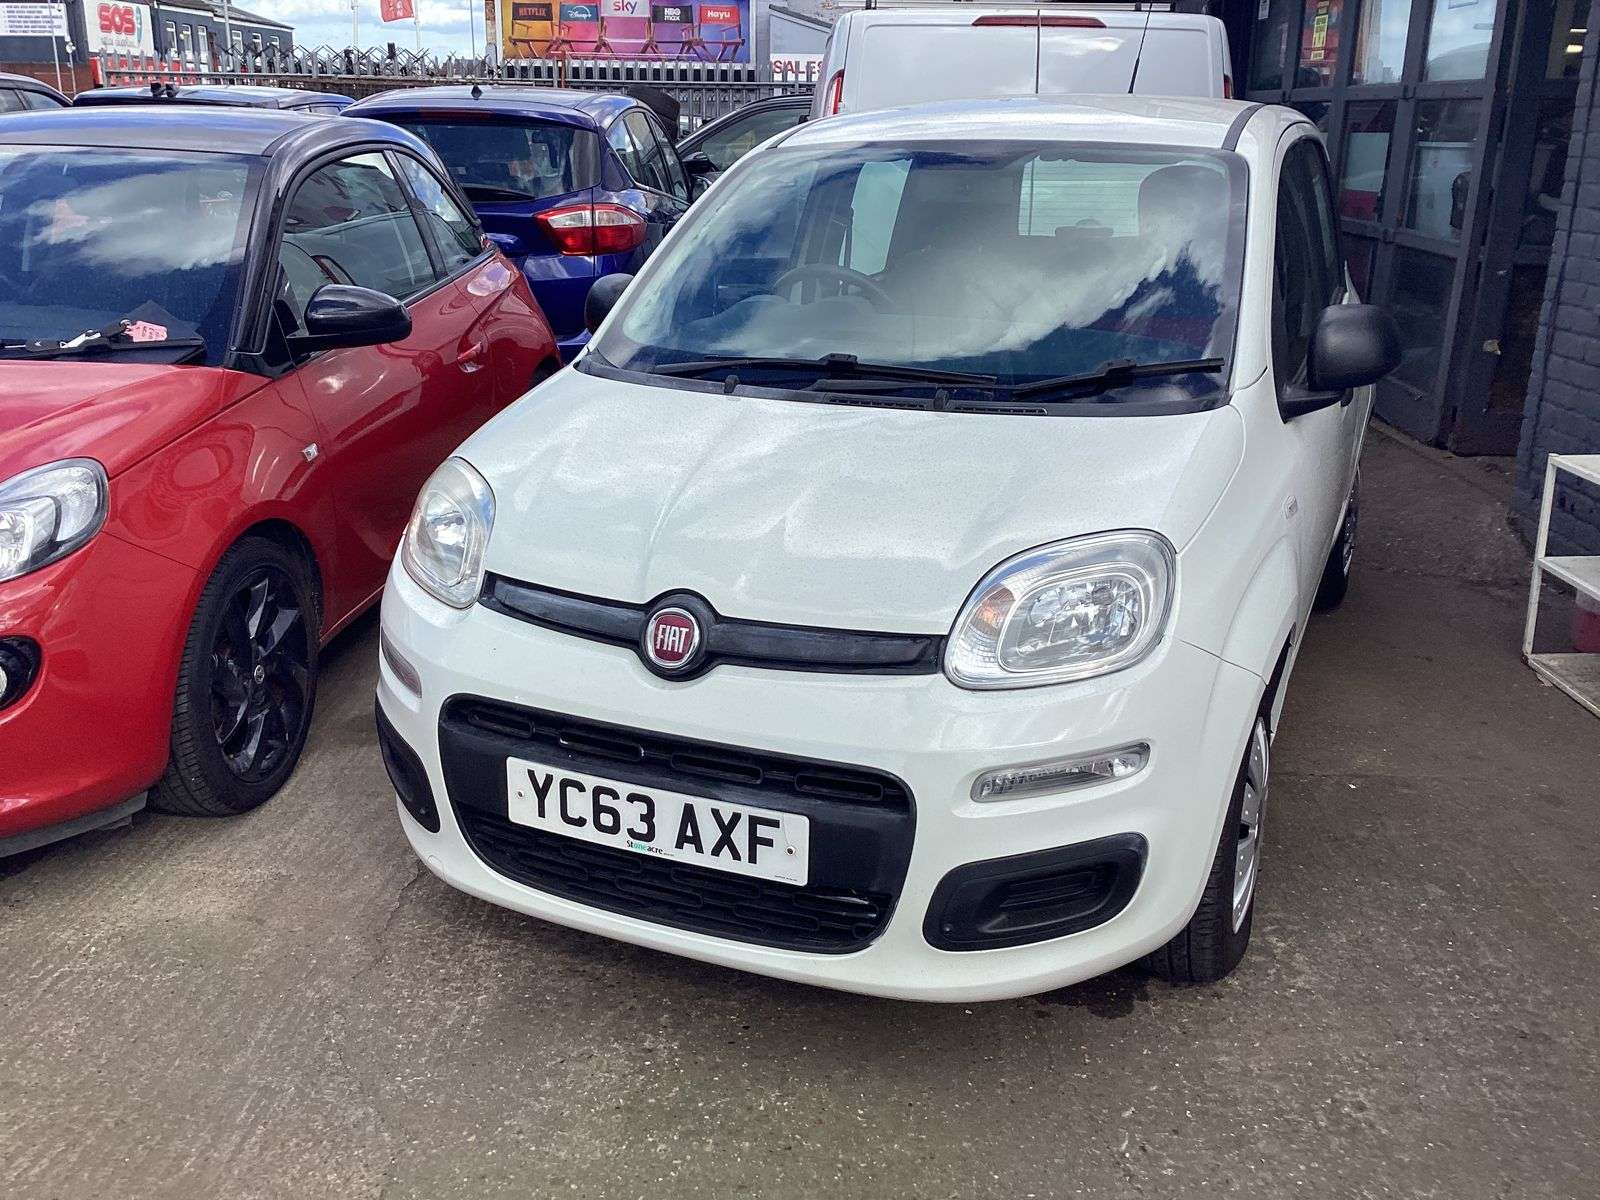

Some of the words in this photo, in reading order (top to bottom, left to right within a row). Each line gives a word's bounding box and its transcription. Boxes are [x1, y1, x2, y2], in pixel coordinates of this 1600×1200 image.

[518, 7, 546, 17] NETFLIX
[613, 0, 637, 14] sky
[664, 7, 681, 15] HBO
[707, 10, 731, 19] Hayu
[98, 3, 135, 35] SOS
[656, 624, 690, 653] FIAT
[526, 768, 657, 843] YC63
[674, 802, 781, 865] AXF
[626, 839, 663, 855] Stoneacre
